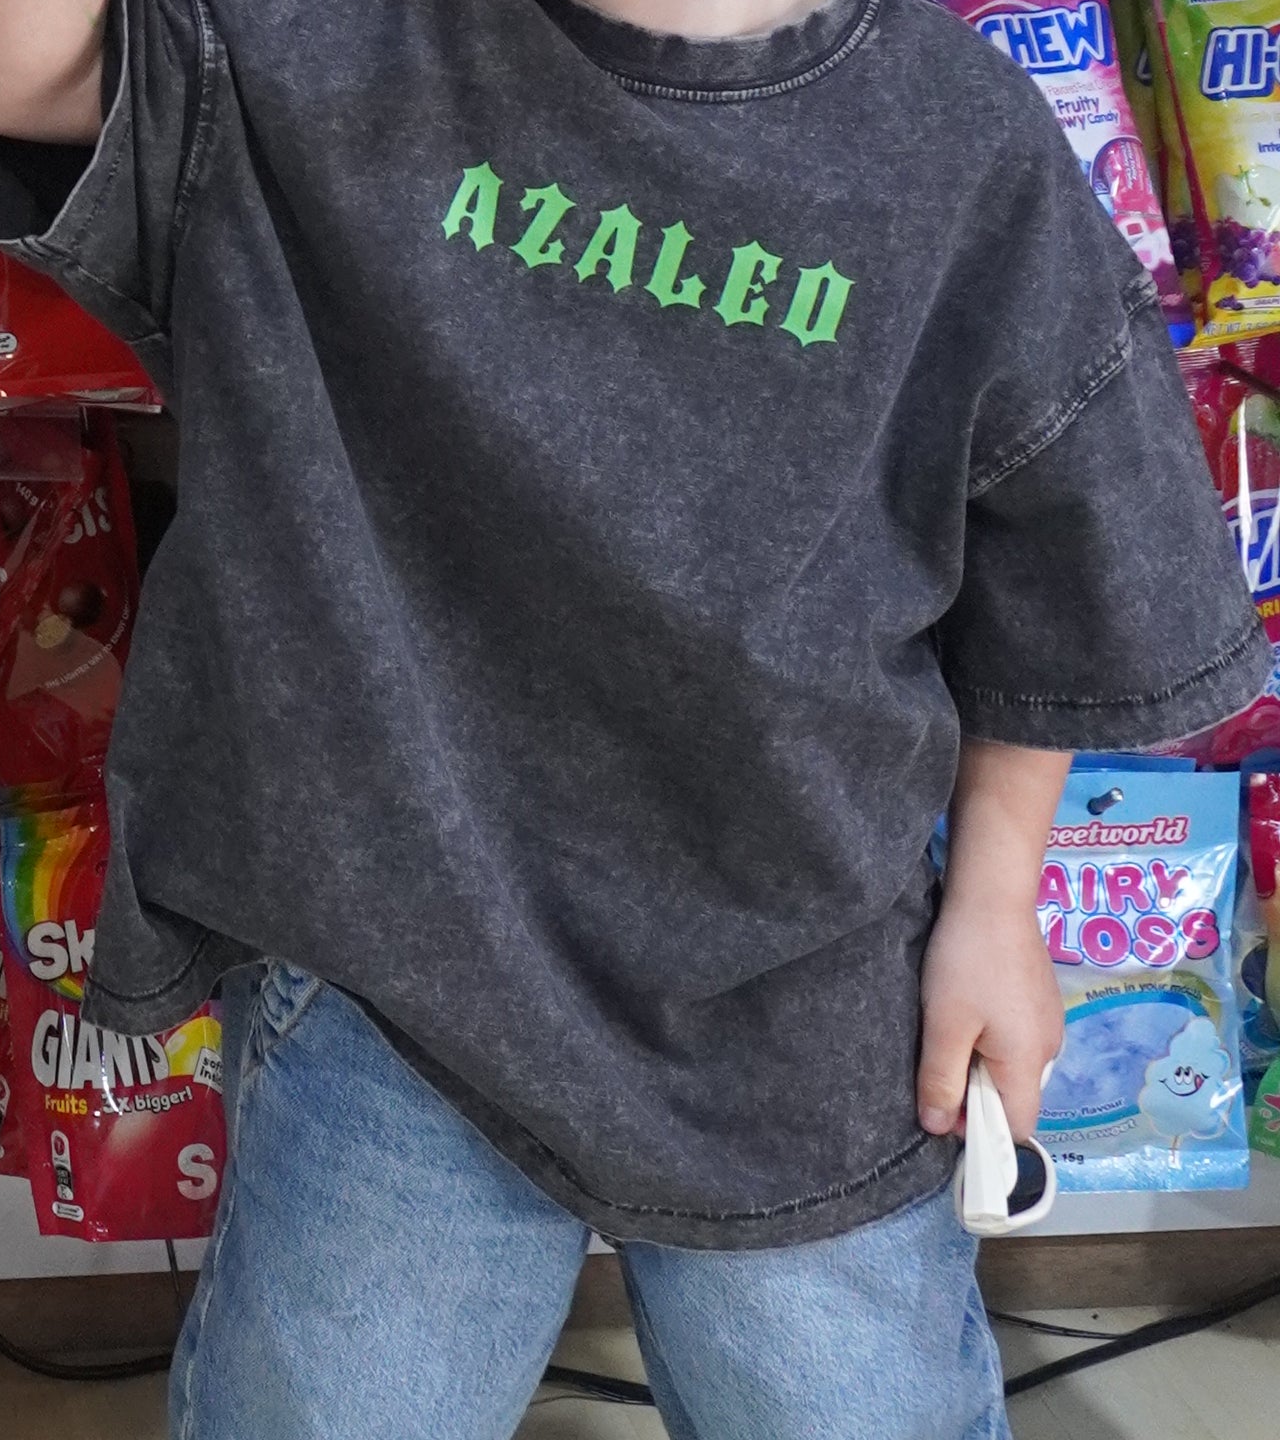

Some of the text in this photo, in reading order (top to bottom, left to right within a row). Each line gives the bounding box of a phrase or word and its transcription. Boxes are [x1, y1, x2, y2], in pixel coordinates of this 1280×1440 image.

[440, 160, 857, 349] AZALEO
[1036, 859, 1192, 916] AIRY
[1047, 908, 1221, 969] LOSS
[1086, 986, 1121, 1003] Melts
[1124, 983, 1134, 996] in
[1137, 982, 1168, 996] your
[44, 1094, 88, 1116] Fruits
[135, 1086, 194, 1114] bigger!
